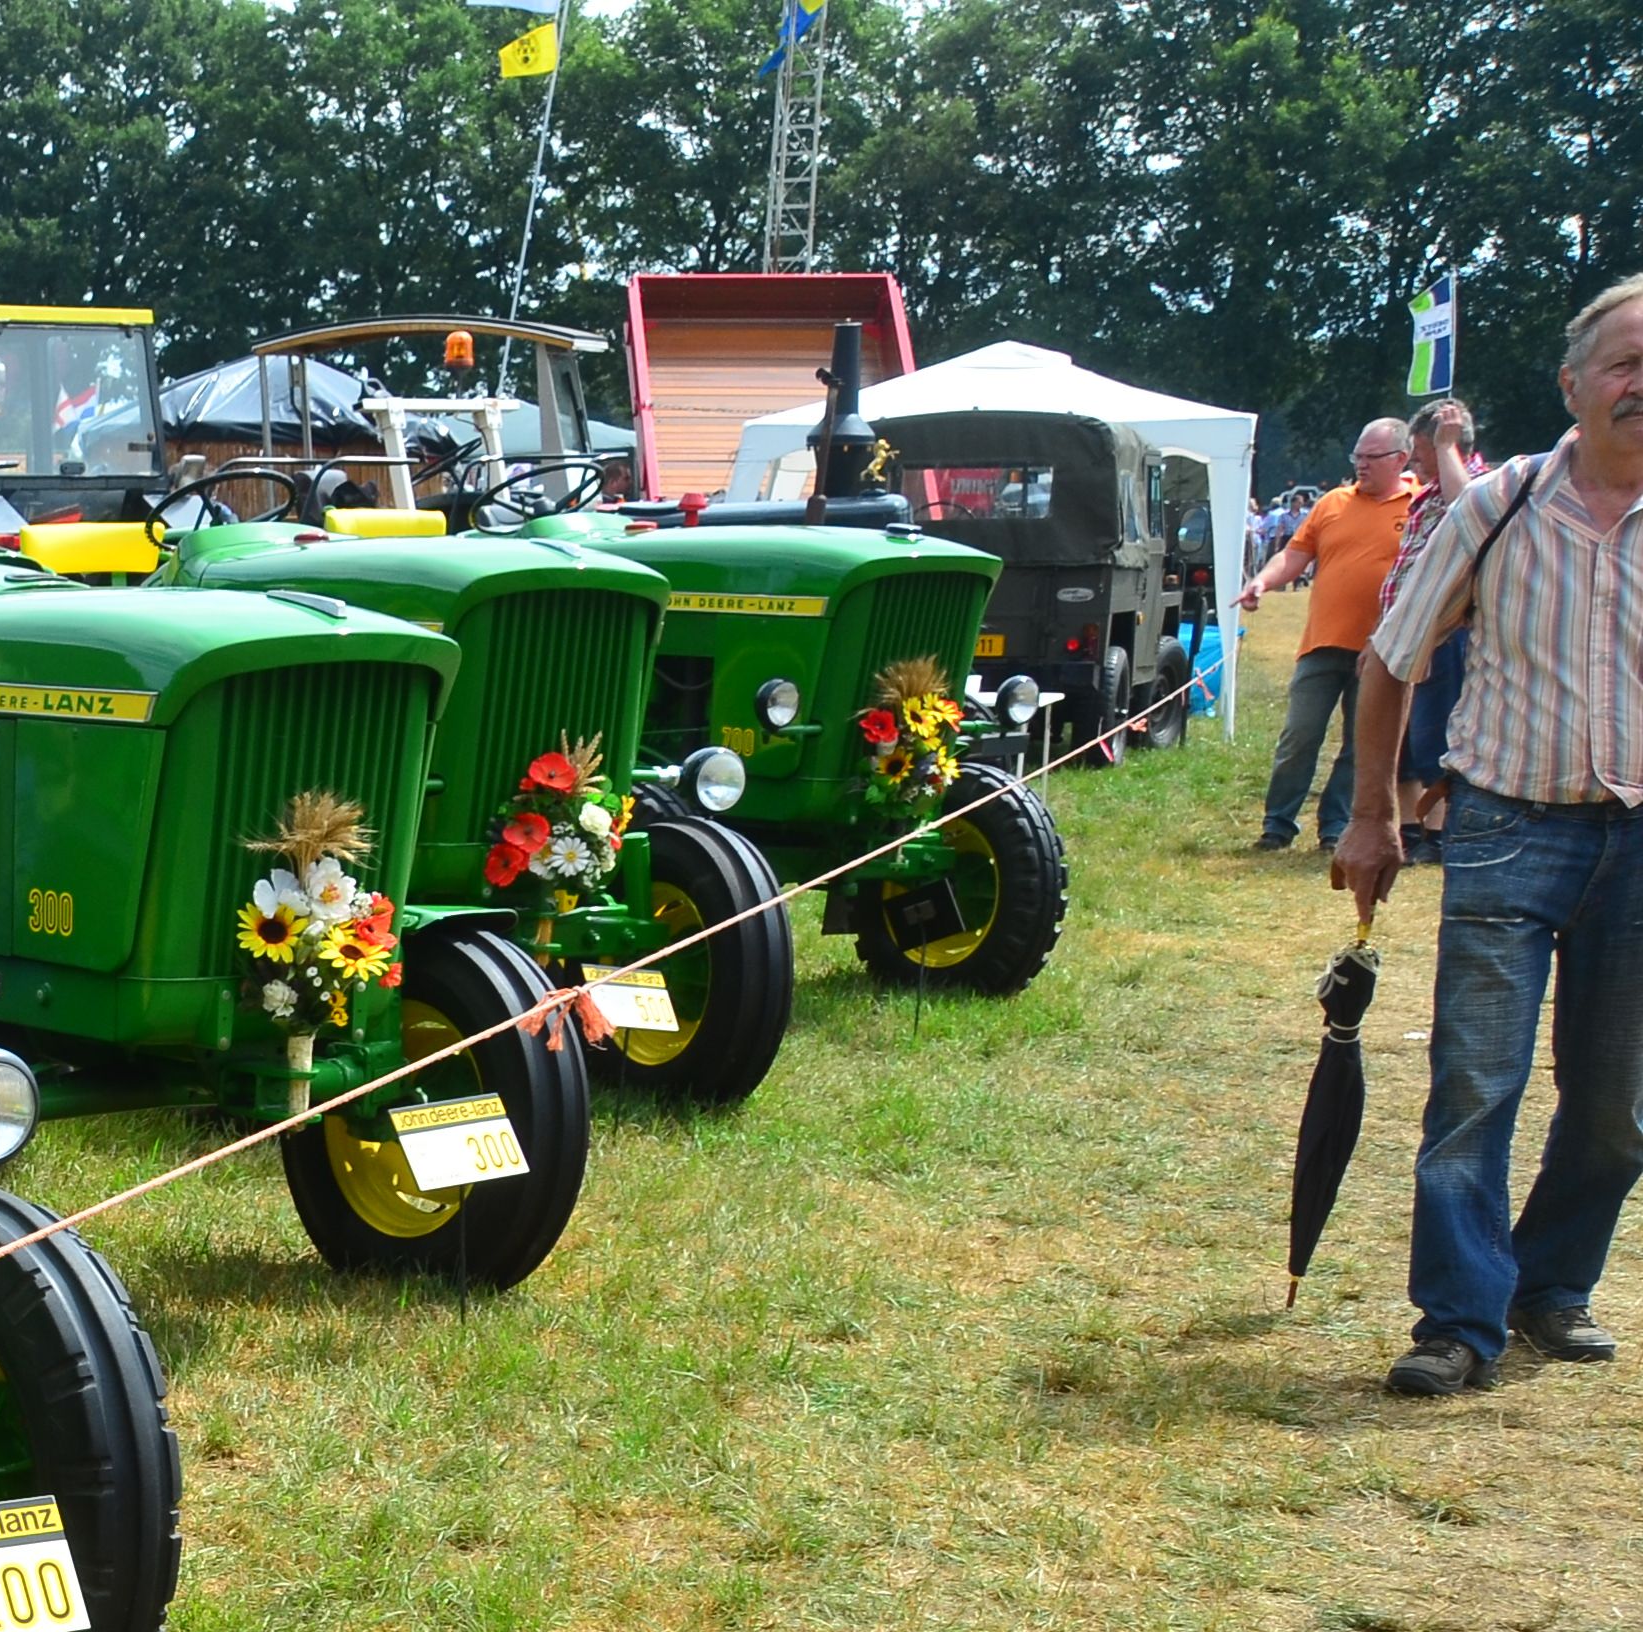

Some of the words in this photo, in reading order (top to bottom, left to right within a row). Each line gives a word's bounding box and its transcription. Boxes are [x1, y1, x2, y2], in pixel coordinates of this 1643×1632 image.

[723, 727, 754, 756] 700
[29, 888, 73, 936] 300
[467, 1131, 520, 1172] 300
